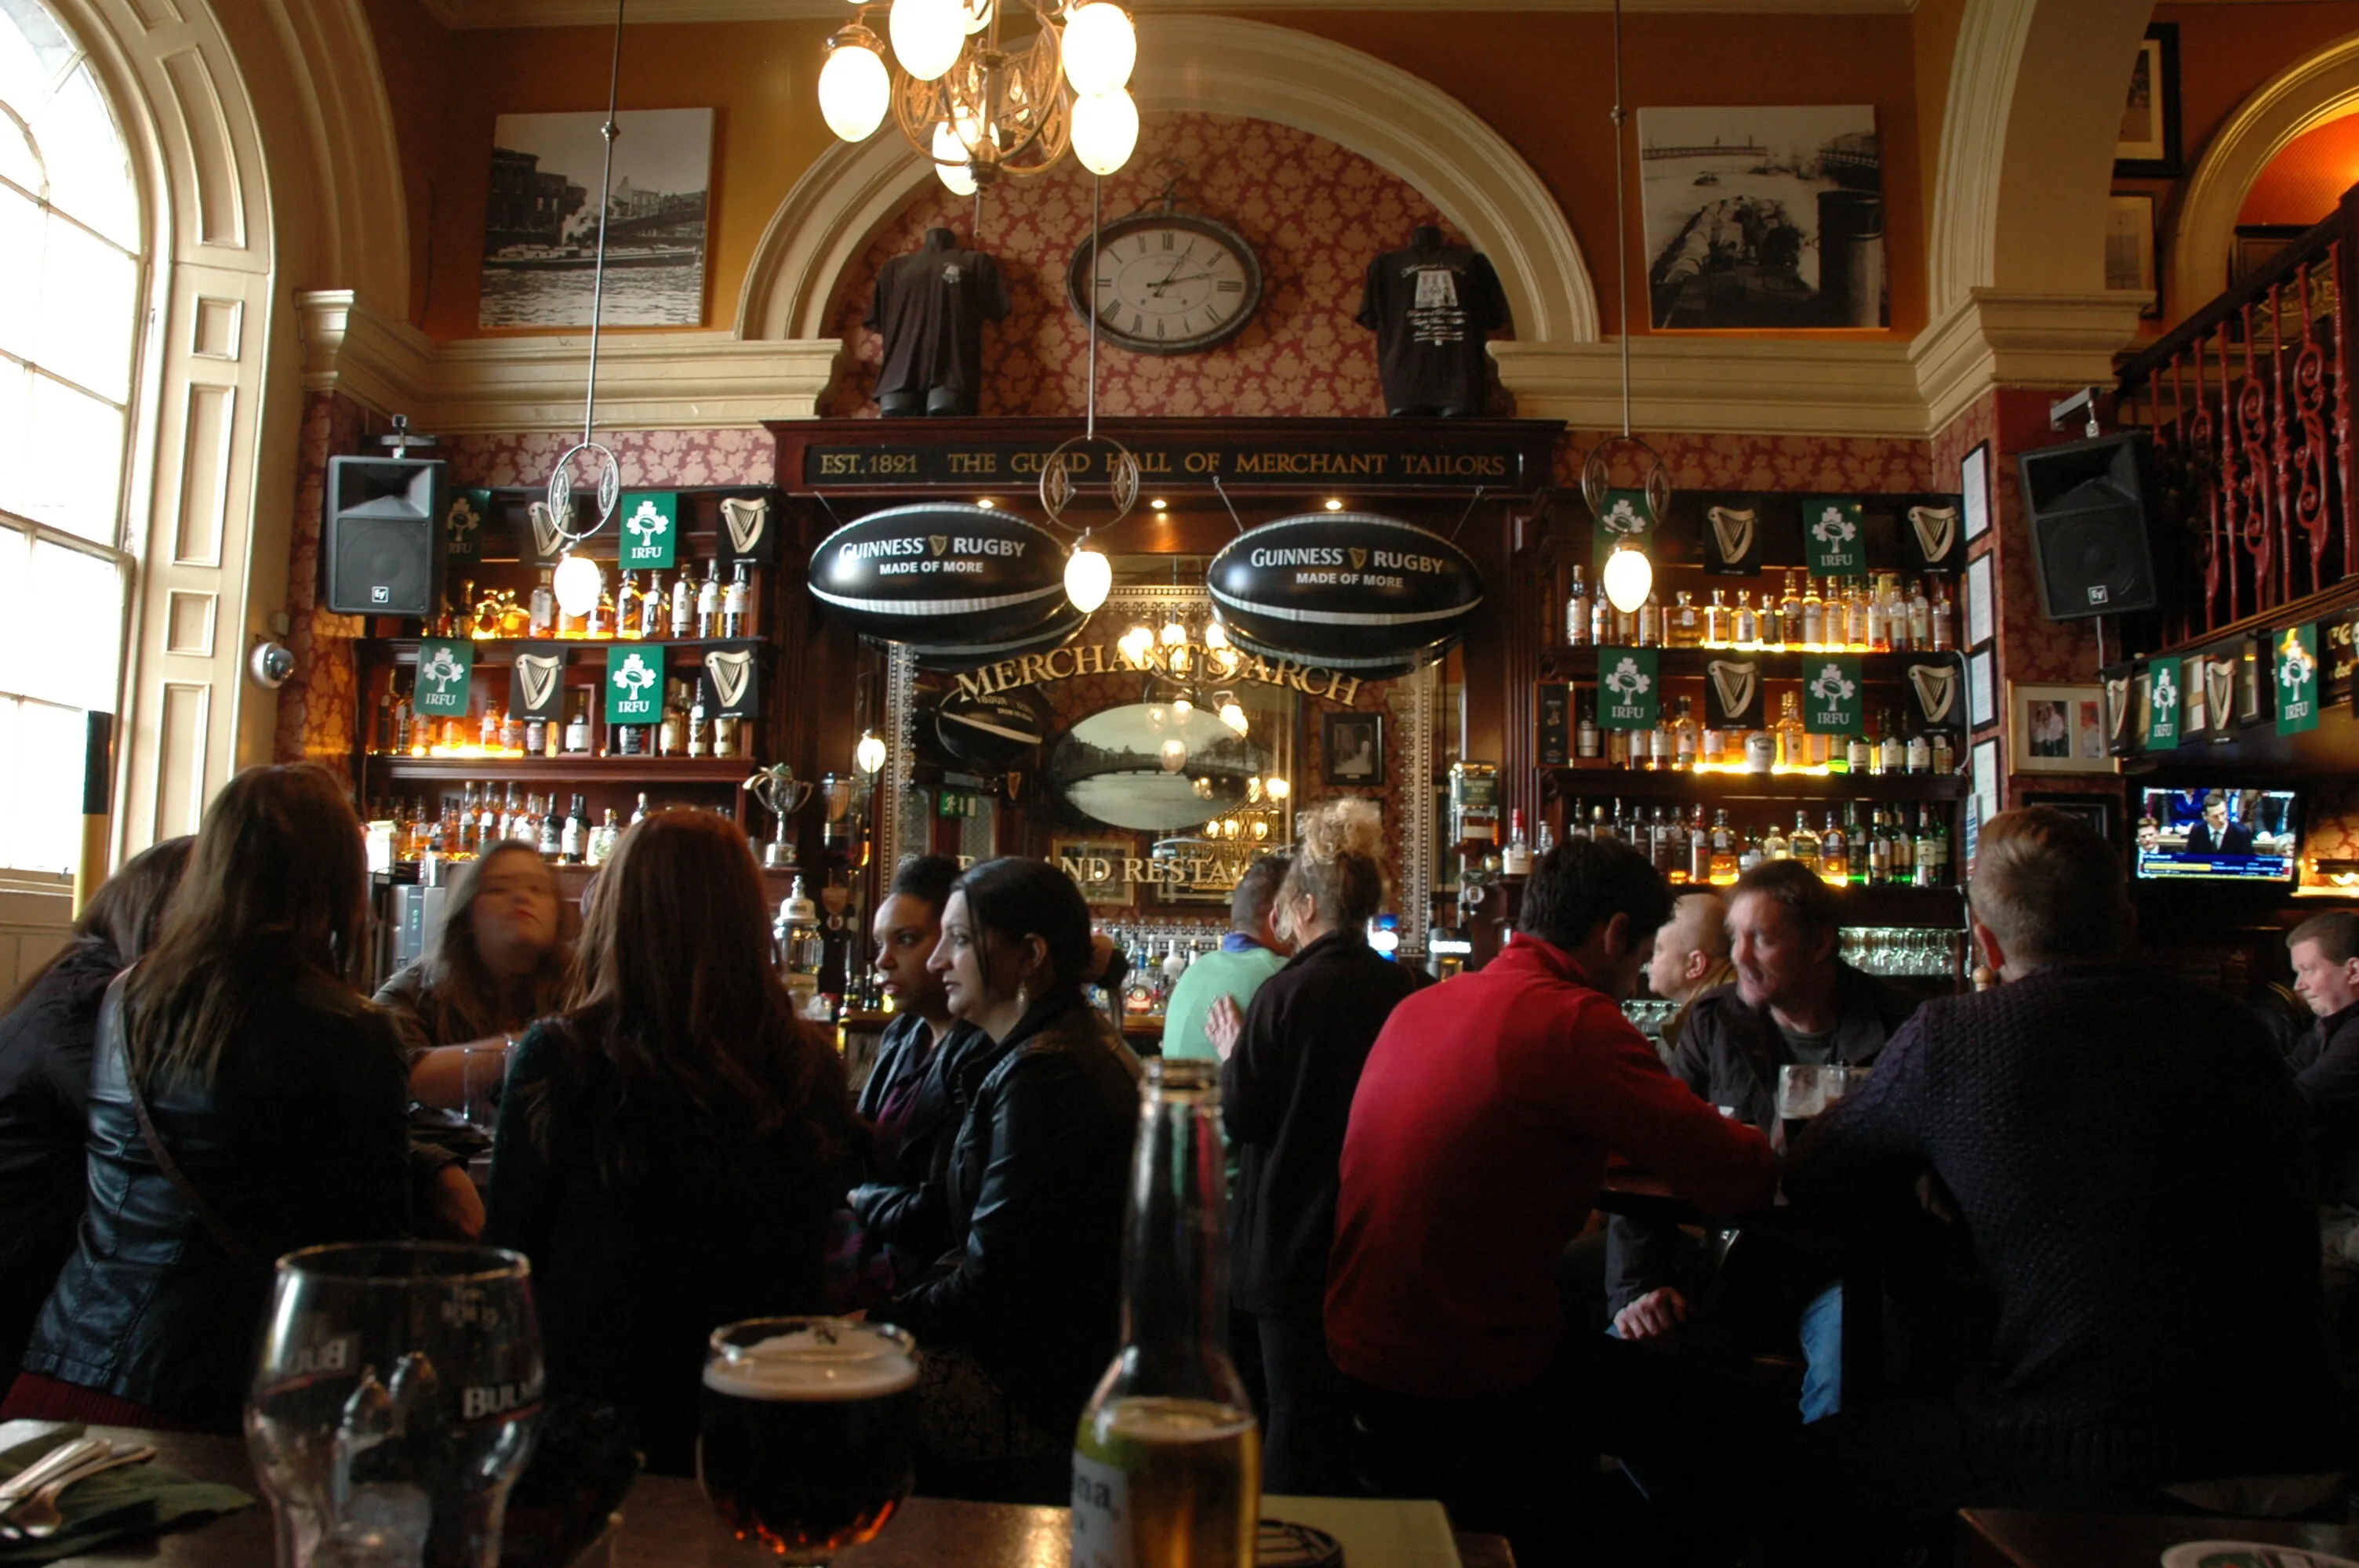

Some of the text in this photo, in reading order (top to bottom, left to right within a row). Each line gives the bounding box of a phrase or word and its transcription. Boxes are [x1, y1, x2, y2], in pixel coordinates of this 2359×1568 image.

[820, 454, 865, 474] EST.
[869, 455, 918, 474] 1891
[947, 453, 997, 474] THE
[1104, 452, 1172, 473] HALL
[1184, 452, 1221, 472] OF
[1235, 453, 1388, 475] MERCHANT
[1401, 455, 1505, 476] TAILORS
[448, 542, 473, 554] RFU
[631, 546, 663, 559] IRFU
[839, 536, 1027, 561] GUINNESS RUGBY
[1250, 548, 1443, 575] GUINNESS RUGBY
[1820, 554, 1853, 567] IRFU
[879, 561, 983, 575] MADE OF MORE
[1296, 572, 1404, 588] MADE OF MORE
[954, 642, 1363, 706] MERCHANT'S ARCH
[425, 692, 456, 706] IRFU
[618, 700, 650, 713] IRFU
[1611, 706, 1645, 720] IRFU
[2284, 701, 2309, 720] IRFU
[1817, 712, 1850, 725] IRFU
[2153, 724, 2173, 738] IRFU
[1043, 856, 1111, 883] ND
